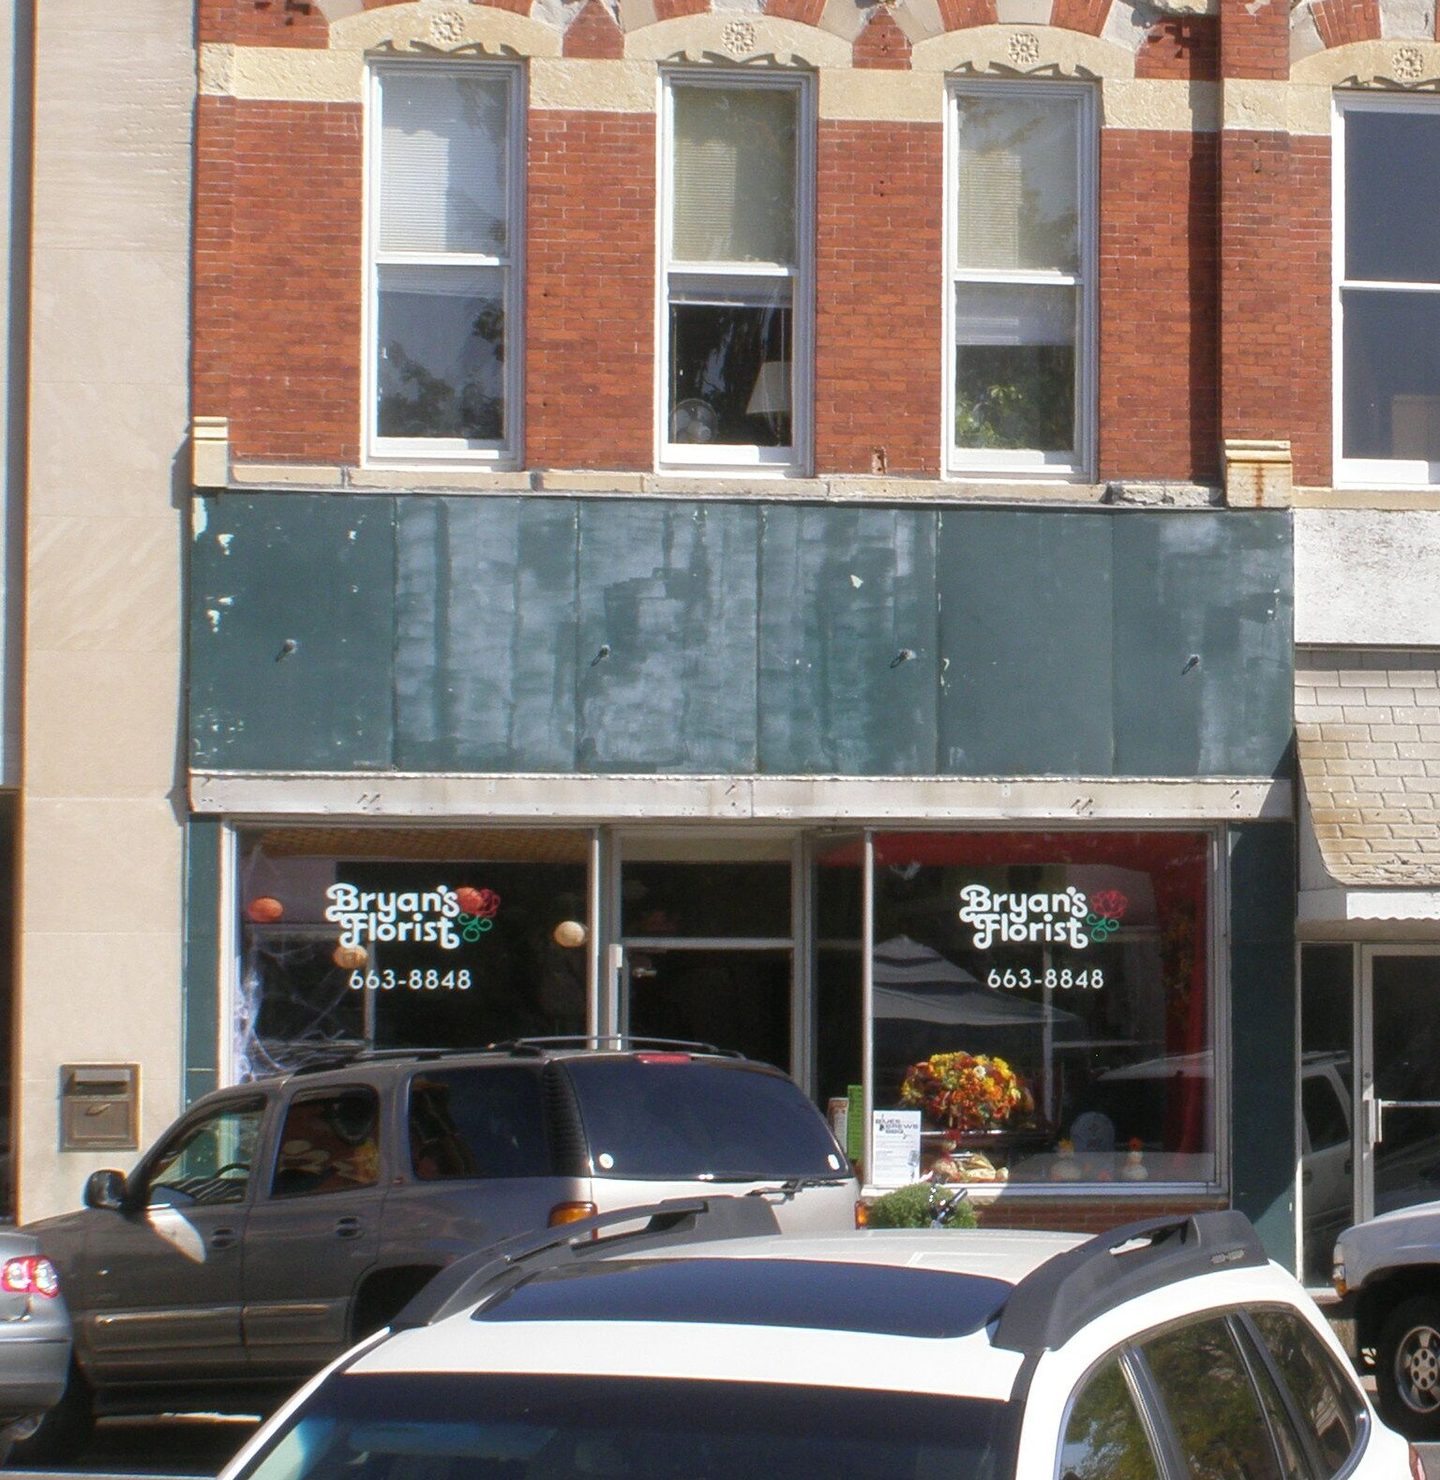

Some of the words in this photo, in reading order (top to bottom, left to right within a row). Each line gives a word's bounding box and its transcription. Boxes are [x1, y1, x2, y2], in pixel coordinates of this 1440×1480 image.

[325, 883, 459, 921] Bryan's
[959, 884, 1089, 922] Bryan's
[339, 912, 460, 949] Florist
[972, 913, 1089, 949] Florist
[348, 969, 472, 991] 663-8848
[987, 968, 1104, 990] 663-8848
